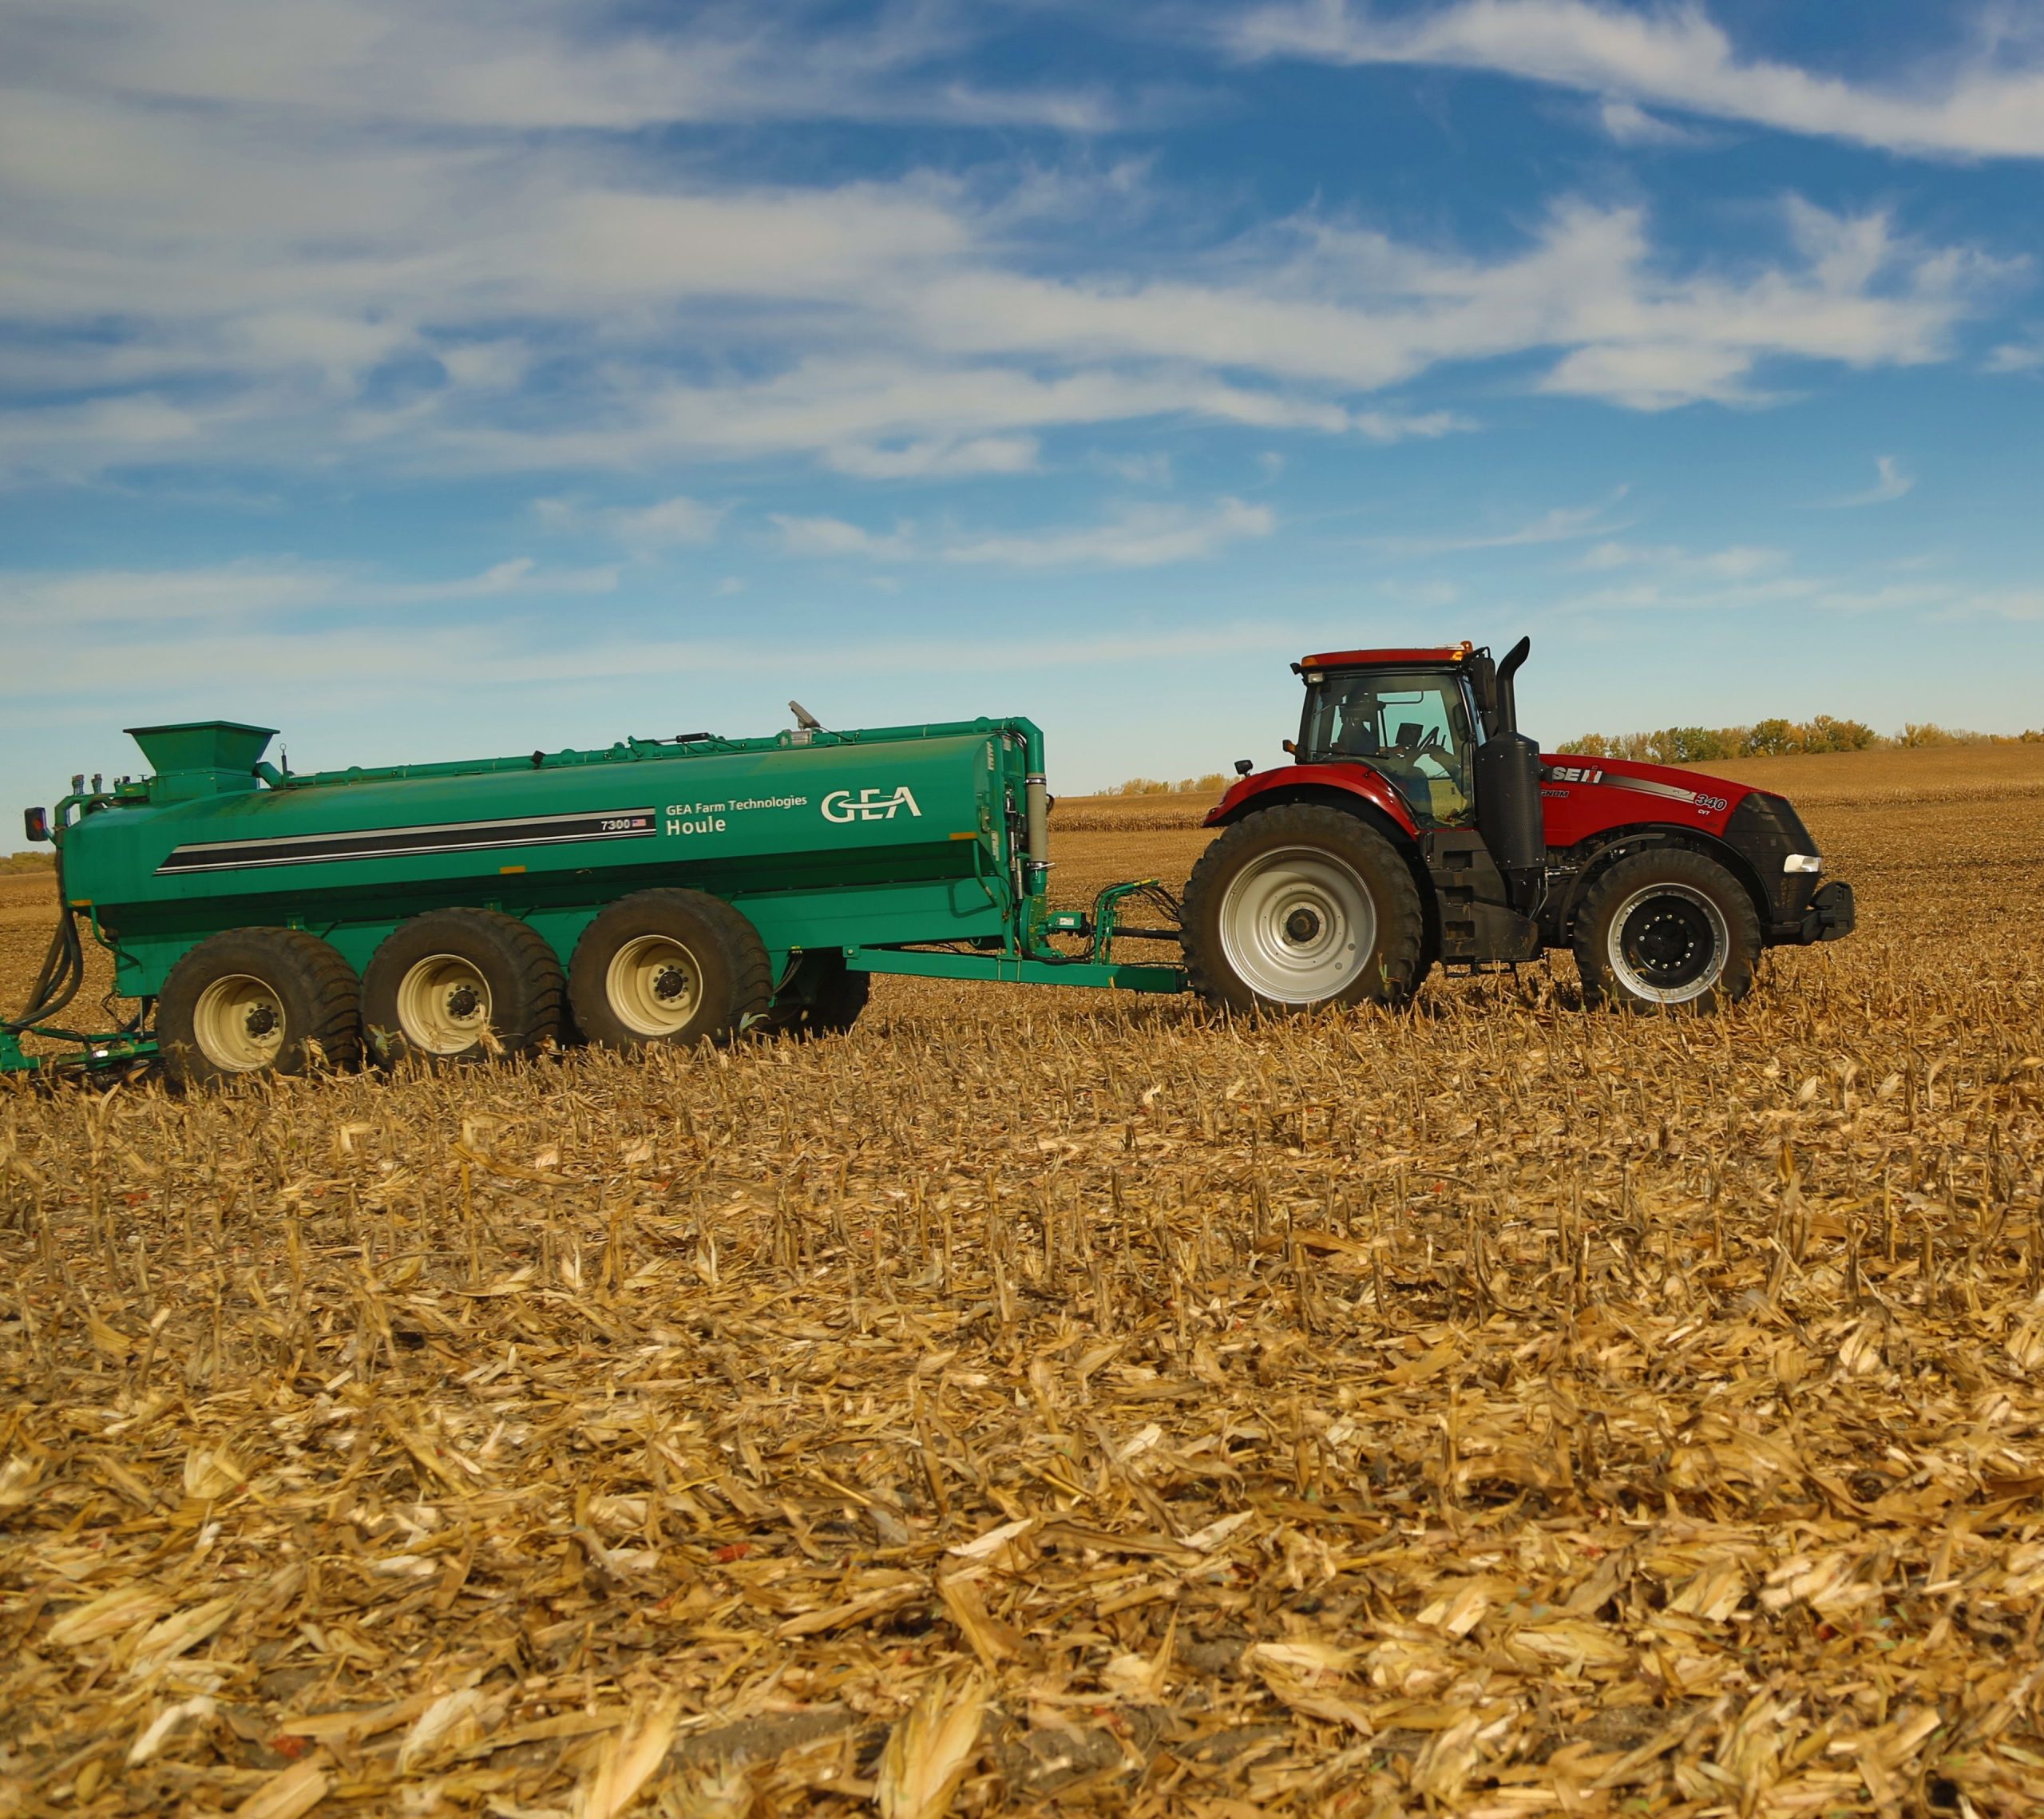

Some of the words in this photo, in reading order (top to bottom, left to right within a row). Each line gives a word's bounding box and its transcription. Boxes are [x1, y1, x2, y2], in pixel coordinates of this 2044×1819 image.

[1553, 767, 1581, 782] SE
[1541, 789, 1570, 799] GNUM
[1694, 794, 1727, 811] 340
[666, 804, 692, 816] GEA
[695, 802, 725, 814] Farm
[728, 795, 808, 811] Technologies
[821, 787, 922, 823] GEA
[600, 818, 631, 831] 7300
[666, 815, 727, 836] Houle
